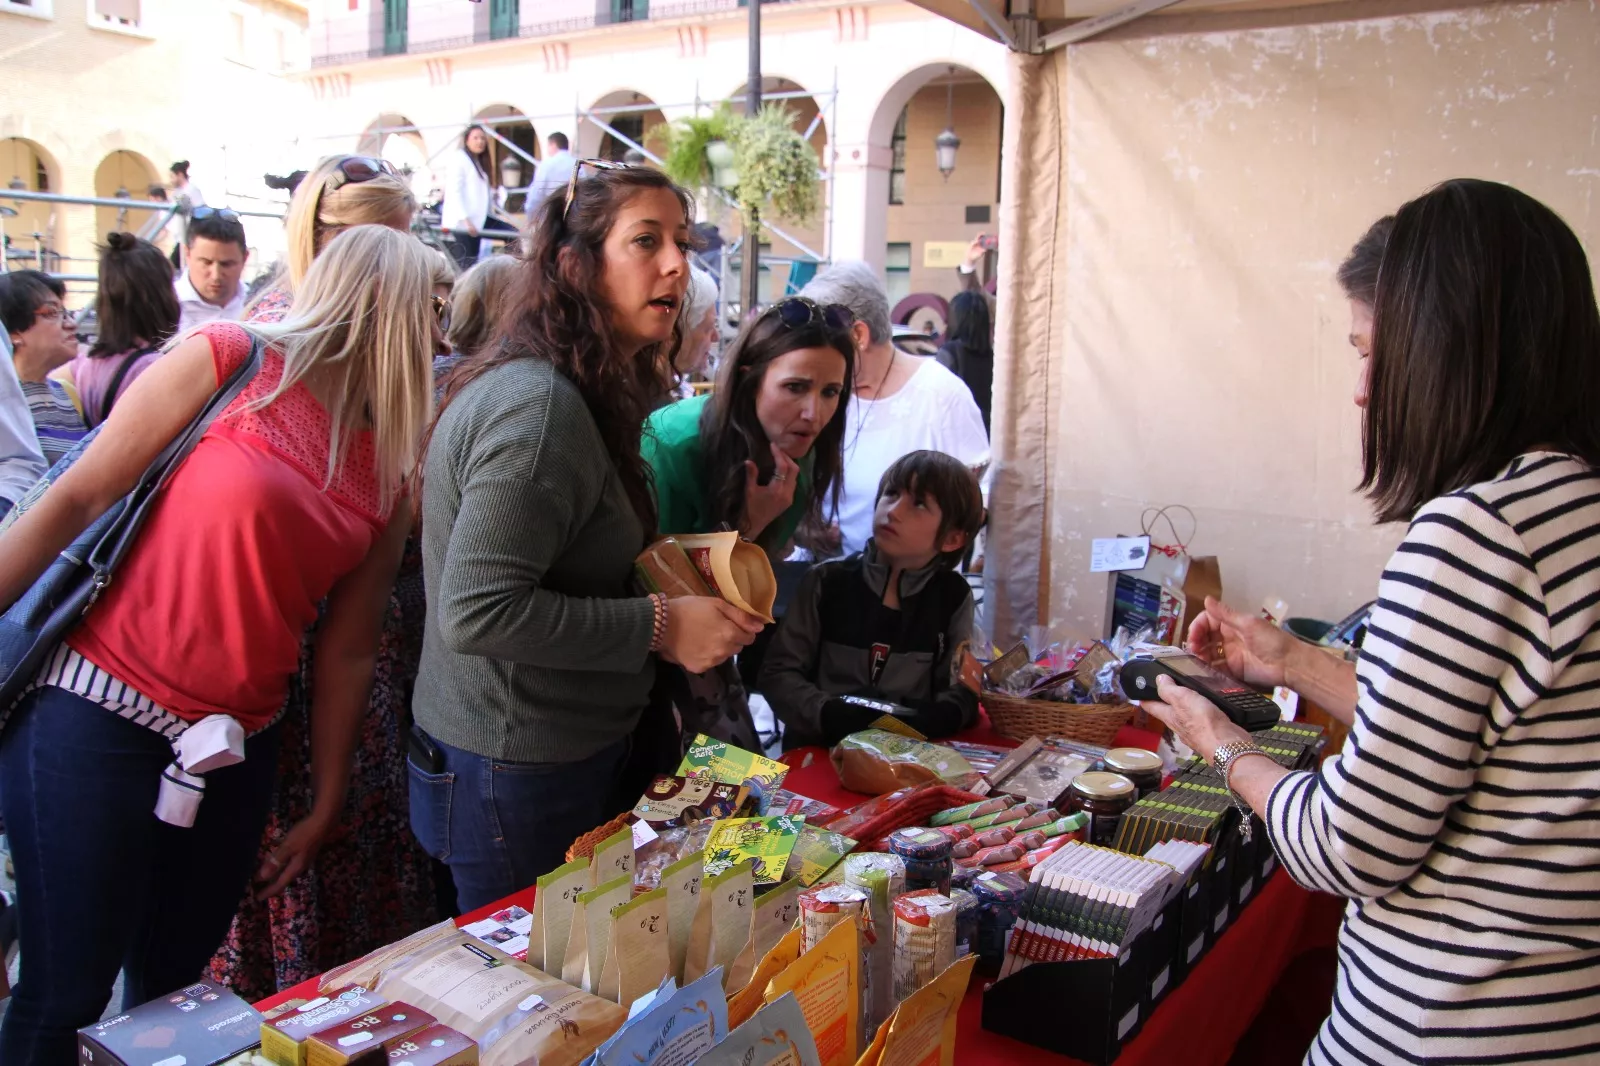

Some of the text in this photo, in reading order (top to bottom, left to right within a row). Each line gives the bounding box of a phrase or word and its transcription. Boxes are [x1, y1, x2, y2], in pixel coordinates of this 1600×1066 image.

[689, 743, 726, 754] Comercio
[756, 757, 777, 770] 100 g.
[690, 779, 702, 787] 100
[207, 1010, 253, 1032] liofilizado
